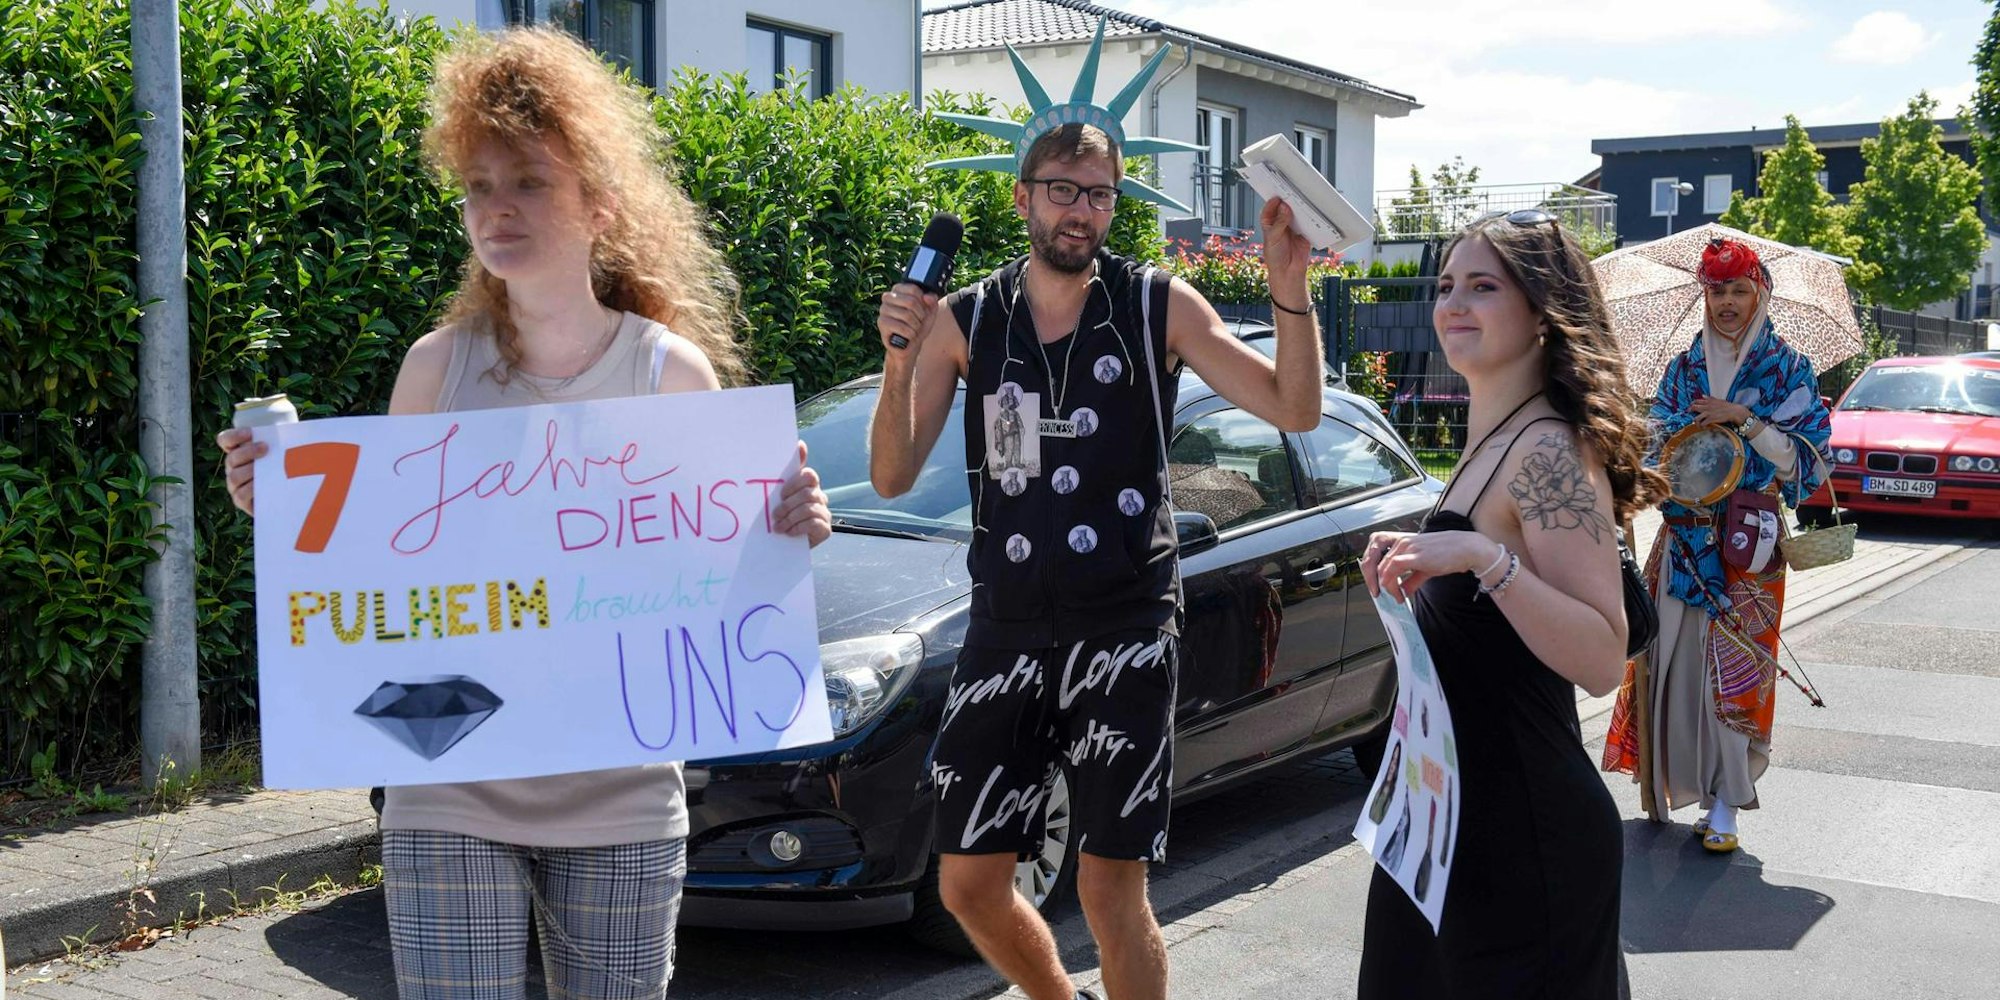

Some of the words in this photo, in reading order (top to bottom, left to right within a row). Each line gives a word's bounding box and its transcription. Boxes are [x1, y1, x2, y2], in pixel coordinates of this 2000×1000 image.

[283, 442, 361, 554] 7
[390, 420, 680, 555] Jahre
[556, 478, 785, 552] DIENST
[1869, 478, 1885, 490] BM
[1893, 480, 1909, 492] SD
[1911, 481, 1934, 493] 489
[288, 576, 551, 647] PULHEIM
[616, 603, 806, 751] UNS
